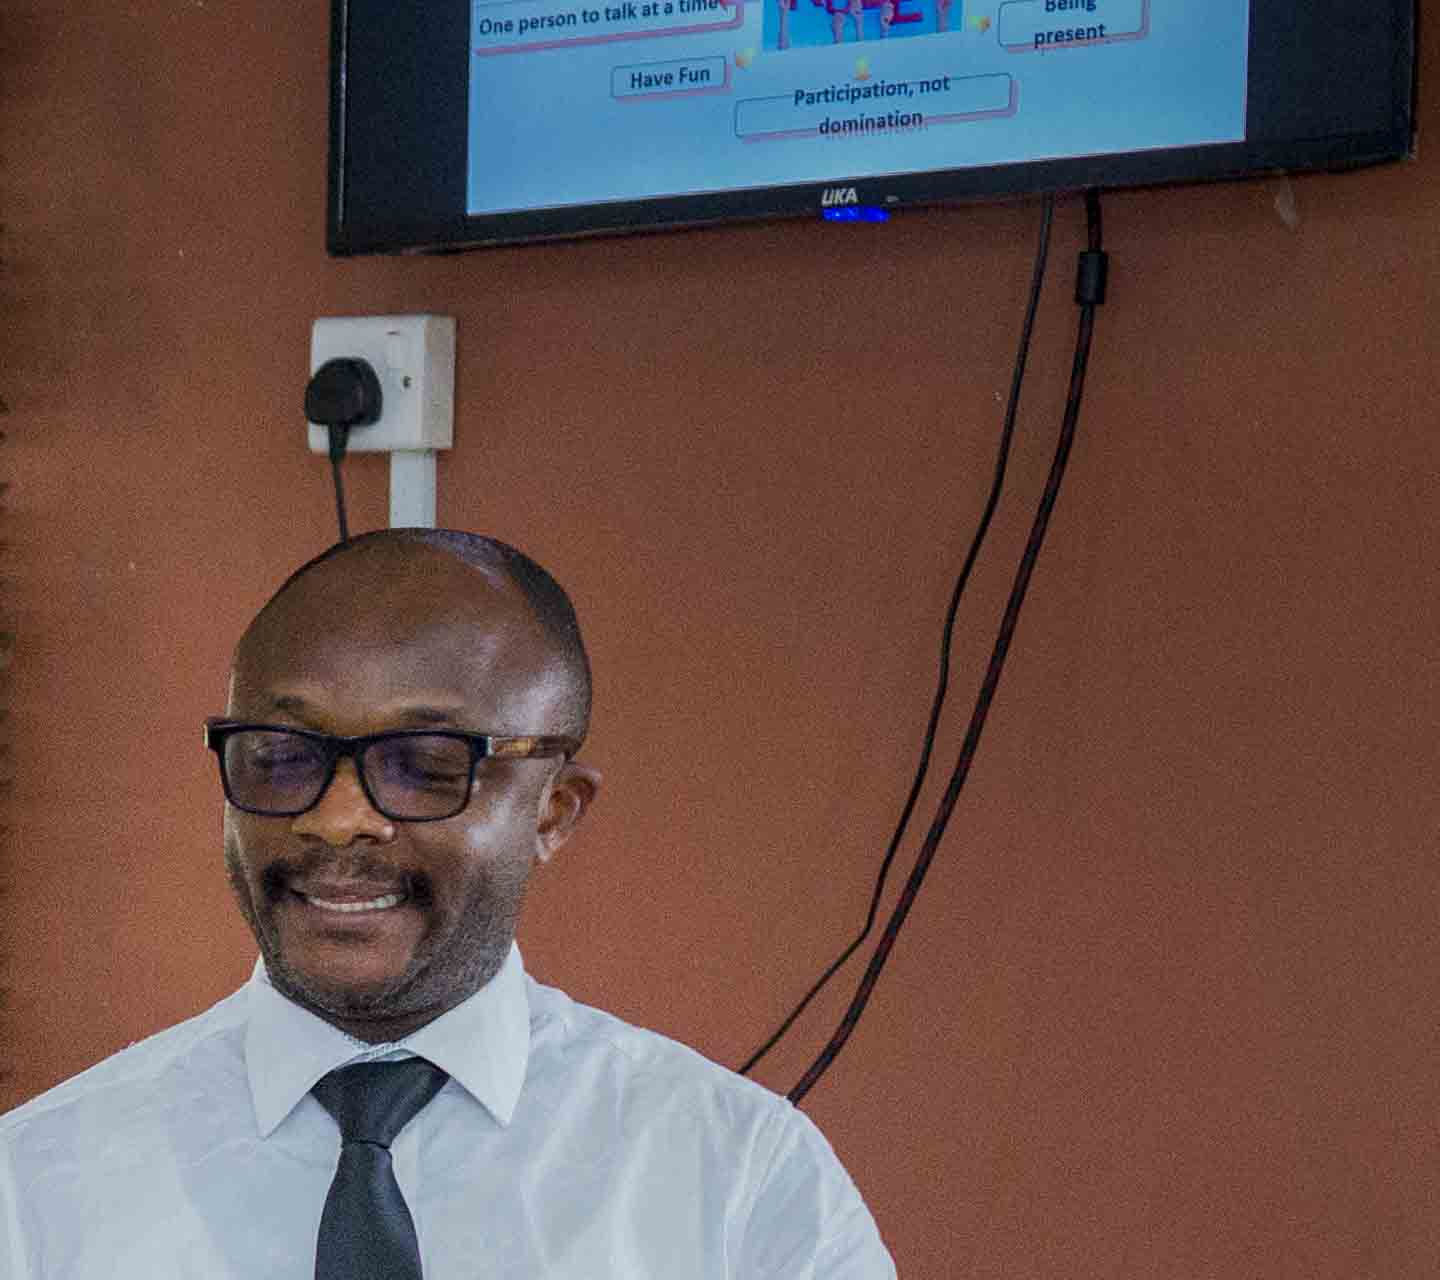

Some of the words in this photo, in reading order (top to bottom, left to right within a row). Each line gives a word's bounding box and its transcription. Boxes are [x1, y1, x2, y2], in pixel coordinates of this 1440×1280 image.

[479, 18, 514, 35] One
[518, 12, 577, 35] person
[582, 9, 600, 24] to
[605, 2, 637, 21] talk
[641, 4, 659, 17] at
[664, 3, 673, 14] a
[679, 0, 718, 14] time
[1044, 0, 1097, 12] Being
[1034, 23, 1106, 49] present
[630, 70, 674, 89] Have
[680, 66, 711, 84] Fun
[793, 79, 915, 106] Participation,
[920, 75, 951, 94] not
[818, 110, 923, 135] domination
